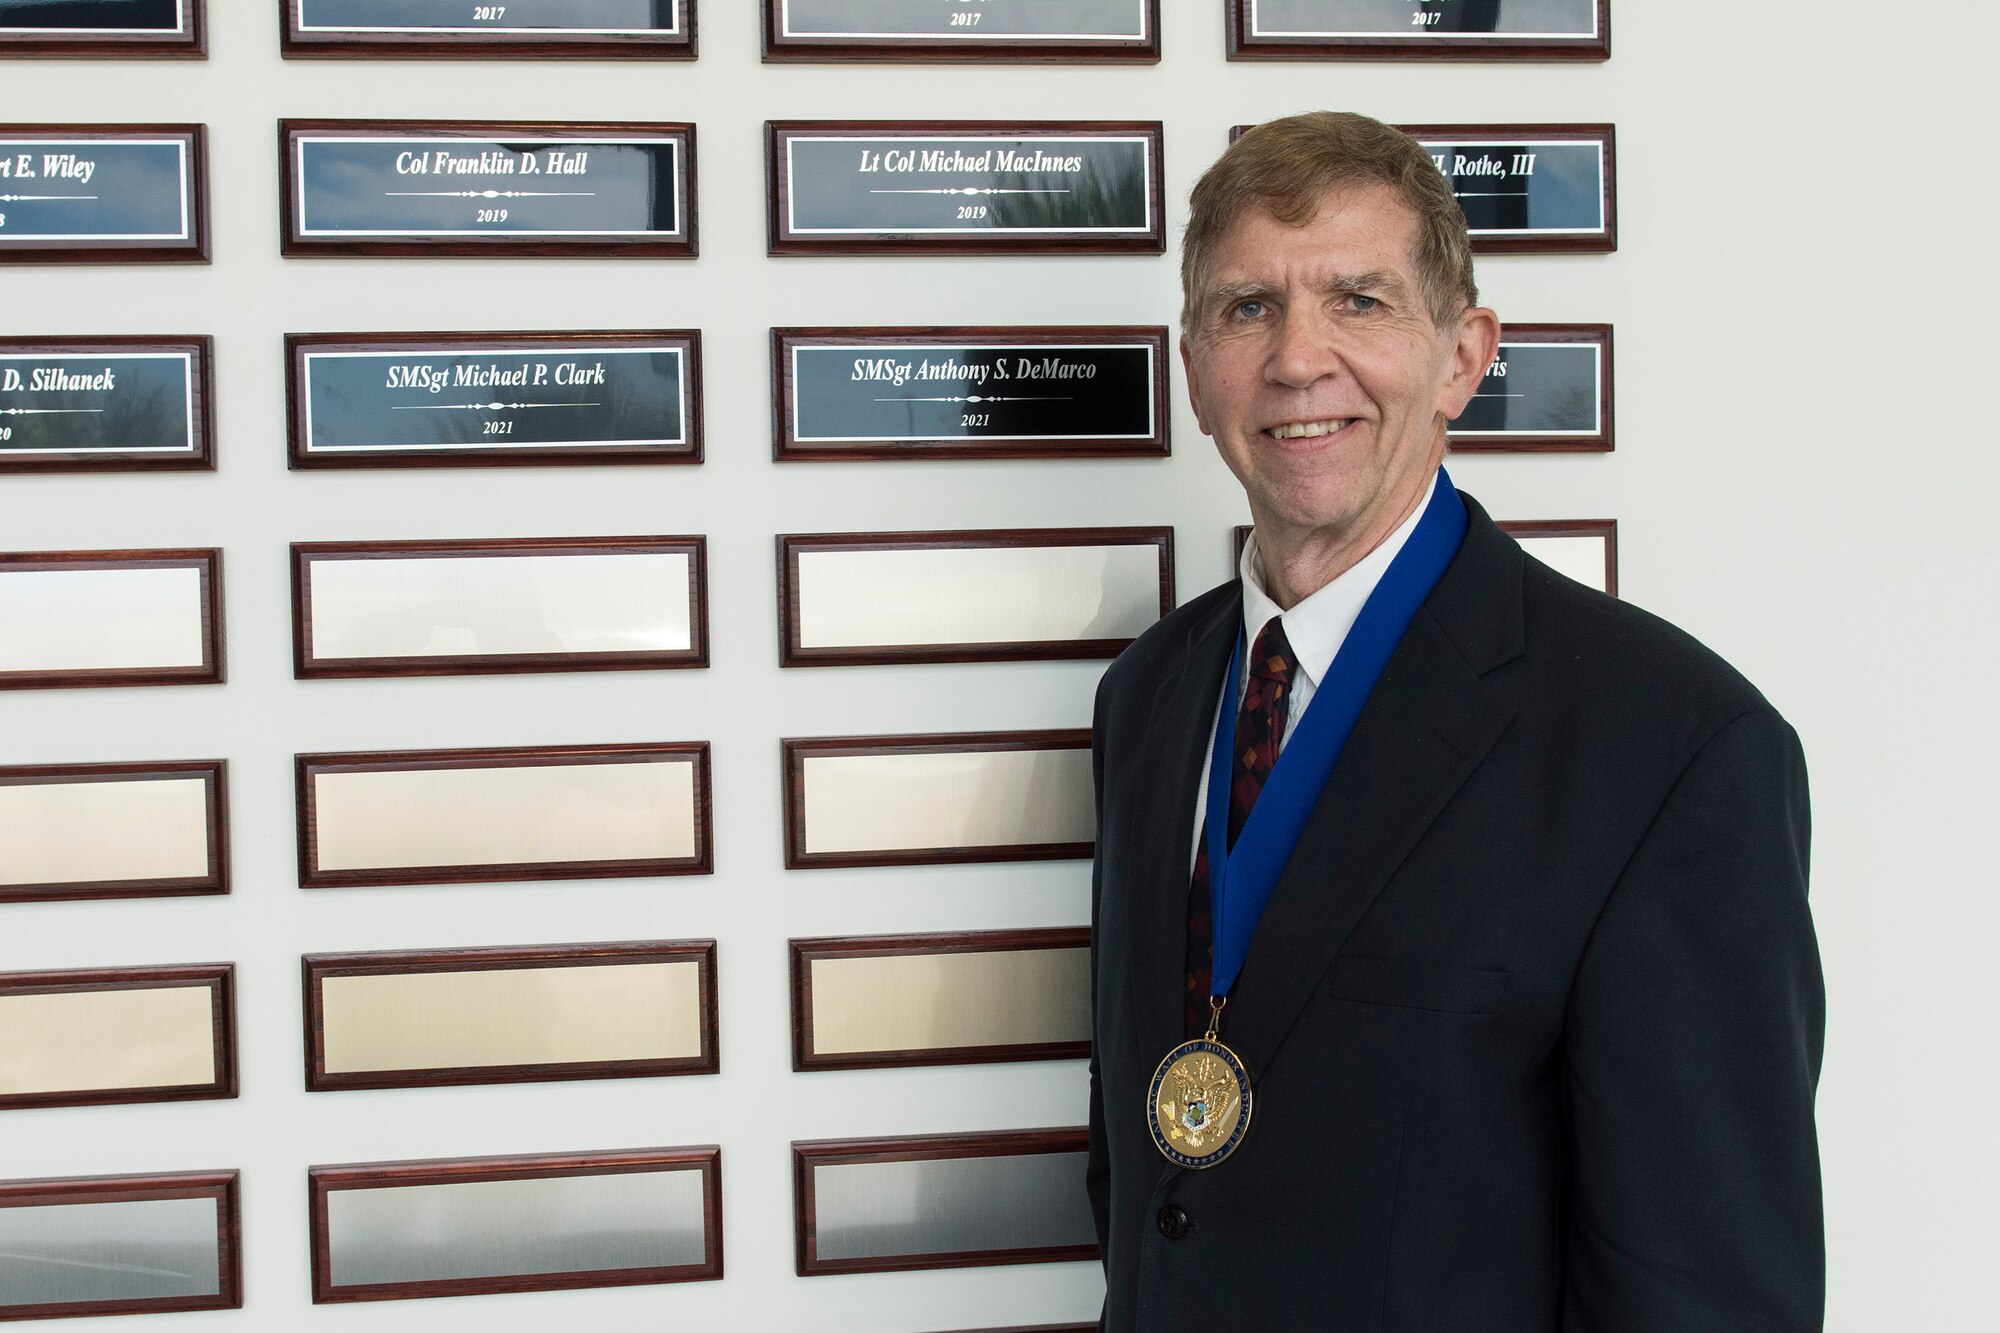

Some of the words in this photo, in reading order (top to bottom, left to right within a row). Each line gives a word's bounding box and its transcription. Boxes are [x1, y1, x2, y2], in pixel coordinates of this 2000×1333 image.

[472, 6, 506, 21] 2017
[950, 12, 981, 26] 2017
[1411, 11, 1442, 25] 2017
[14, 154, 36, 178] E.
[43, 154, 96, 184] Wiley
[395, 151, 429, 175] Col
[432, 151, 515, 175] Franklin
[518, 152, 540, 175] D.
[545, 151, 588, 175] Hall
[858, 150, 880, 173] Lt
[884, 149, 916, 173] Col
[918, 150, 991, 173] Michael
[994, 150, 1082, 173] MacInnes
[1452, 154, 1507, 180] Rothe,
[1510, 153, 1537, 176] III
[476, 209, 508, 223] 2019
[956, 205, 987, 219] 2019
[1, 368, 25, 392] D.
[29, 367, 116, 392] Silhanek
[385, 365, 450, 394] SMSgt
[452, 363, 529, 387] Michael
[531, 363, 548, 386] P.
[554, 362, 606, 386] Clark
[851, 359, 911, 387] SMSgt
[914, 357, 990, 387] Anthony
[993, 357, 1010, 380] S.
[1015, 357, 1097, 380] DeMarco
[482, 420, 513, 435] 2021
[960, 413, 990, 427] 2021
[1184, 1043, 1200, 1053] OF
[1204, 1043, 1240, 1072] HONOR
